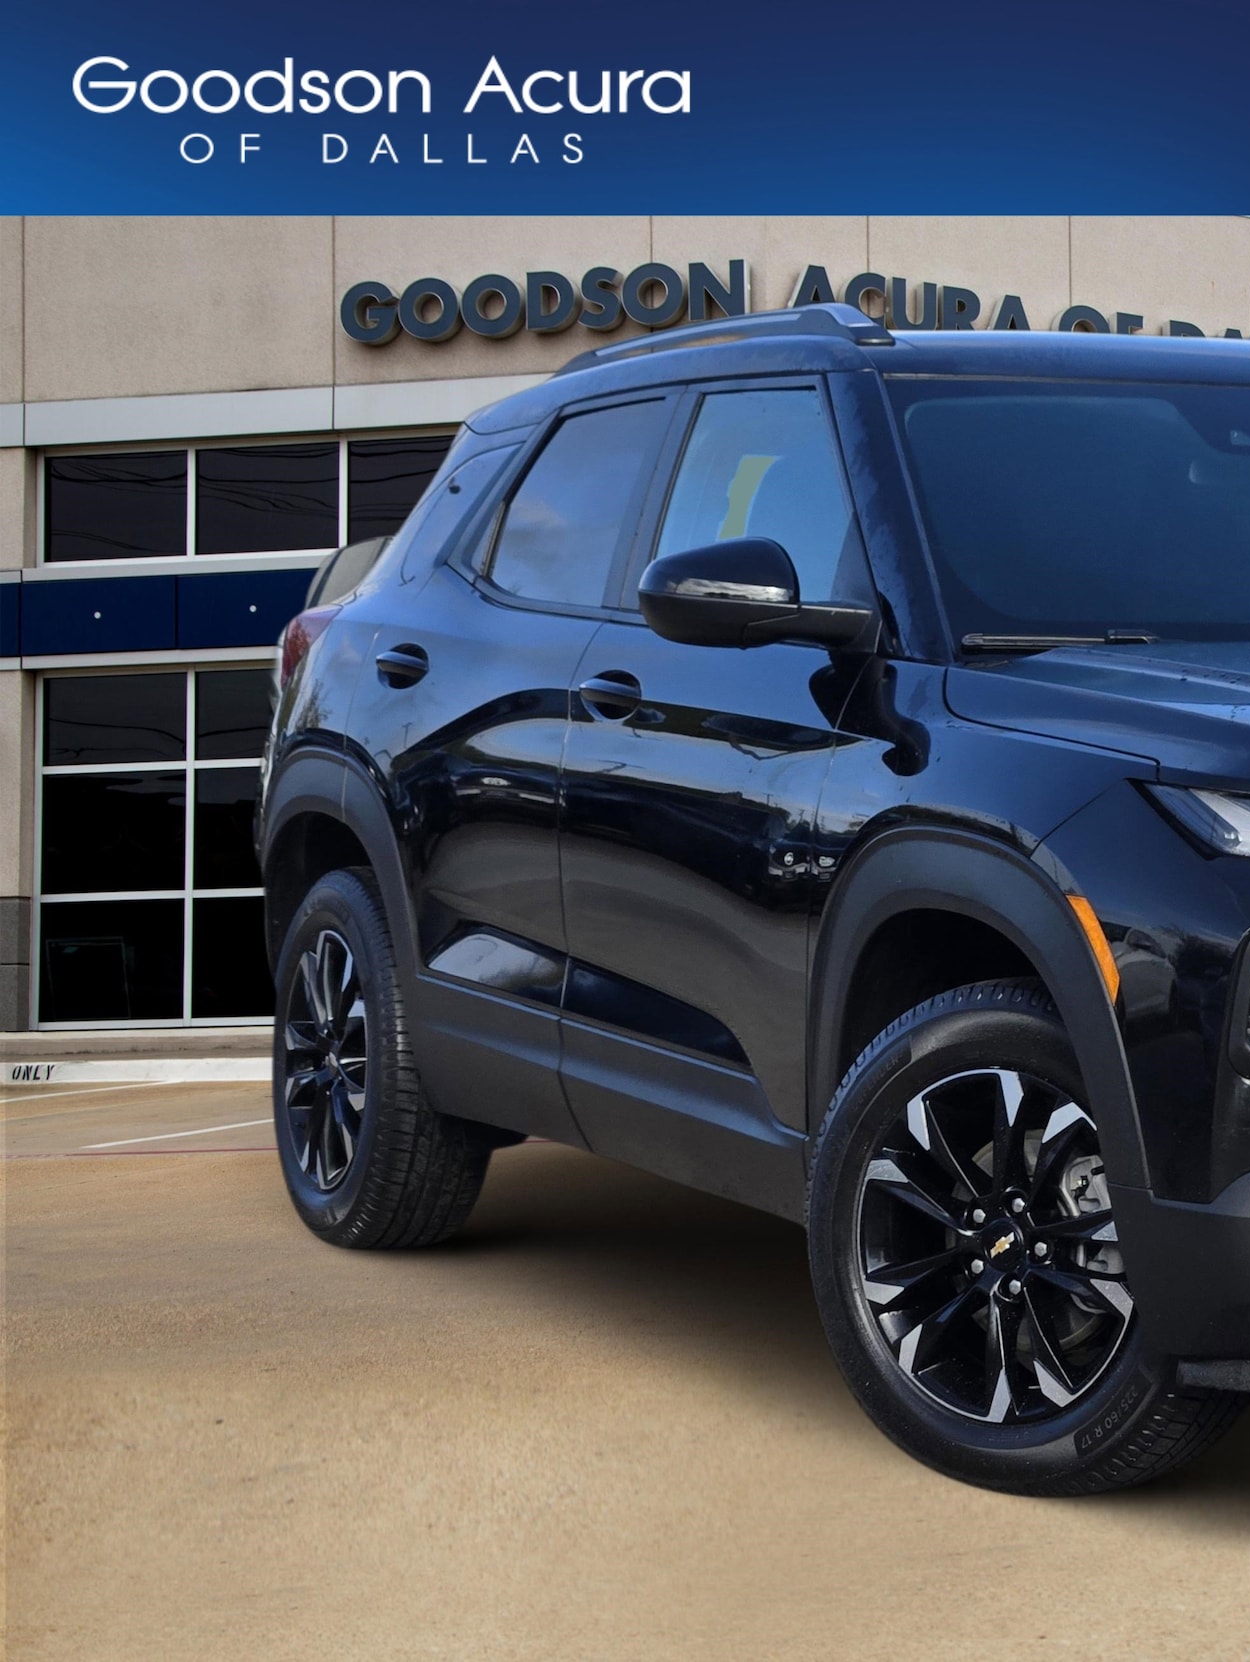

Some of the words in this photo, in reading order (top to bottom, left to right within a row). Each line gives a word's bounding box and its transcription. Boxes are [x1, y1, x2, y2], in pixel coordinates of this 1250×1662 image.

[340, 259, 748, 346] GOODSON
[788, 264, 1031, 331] ACURA
[11, 1064, 55, 1081] ONLY
